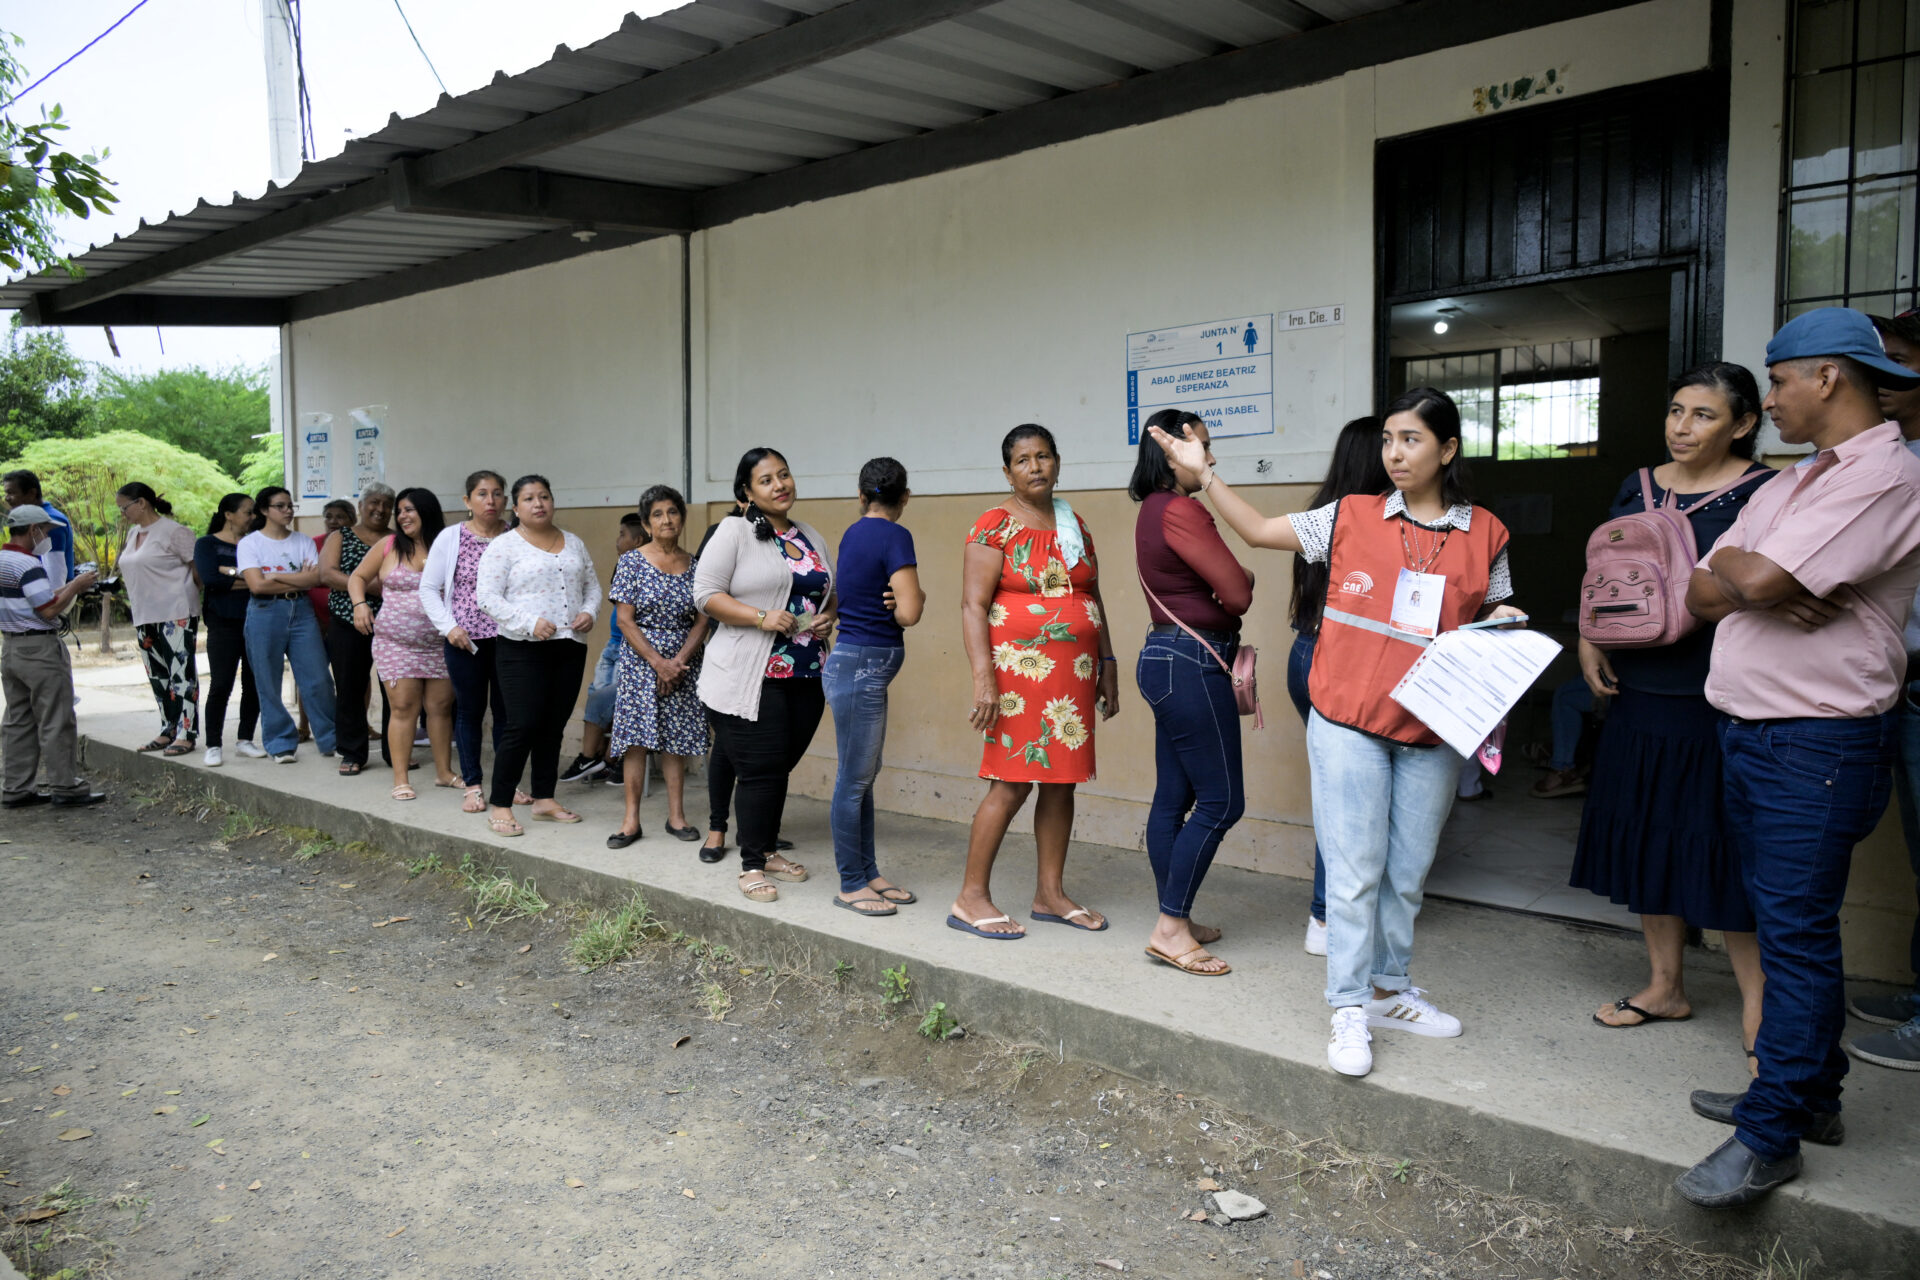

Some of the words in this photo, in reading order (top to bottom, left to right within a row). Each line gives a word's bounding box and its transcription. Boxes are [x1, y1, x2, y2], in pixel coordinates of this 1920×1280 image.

[1309, 310, 1328, 324] Cie.
[1333, 307, 1341, 321] B
[1200, 327, 1228, 339] JUNTA
[1216, 341, 1223, 355] 1
[1151, 375, 1175, 386] ABAD
[1177, 370, 1214, 382] JIMENEZ
[1216, 365, 1256, 378] BEATRIZ
[1175, 380, 1229, 394] ESPERANZA
[1194, 408, 1223, 418] ALAVA
[1225, 404, 1259, 416] ISABEL
[1203, 419, 1223, 429] TINA
